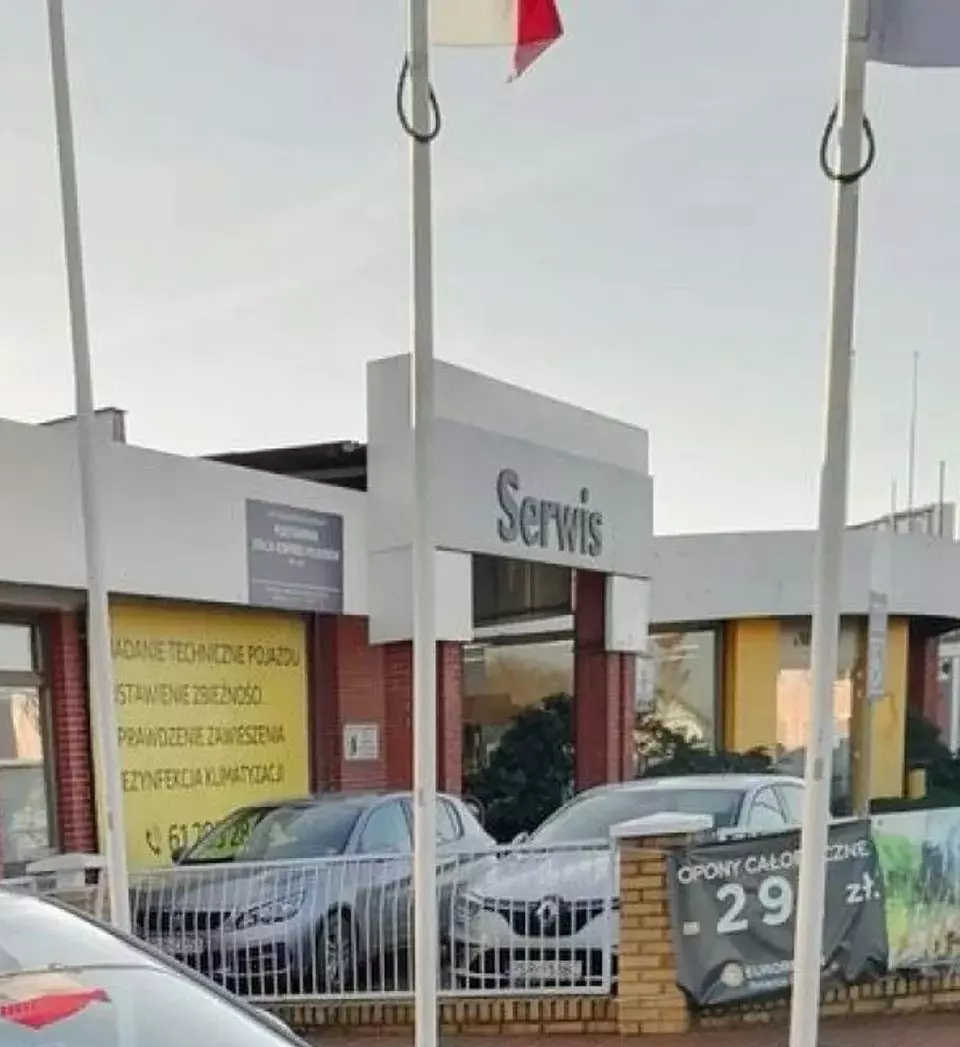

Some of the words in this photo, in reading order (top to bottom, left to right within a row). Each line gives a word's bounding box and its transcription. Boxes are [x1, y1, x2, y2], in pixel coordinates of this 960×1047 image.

[496, 467, 602, 557] Serwis
[111, 637, 166, 662] ADANIE
[115, 682, 191, 705] STAWIENIE
[678, 858, 741, 885] OPONY
